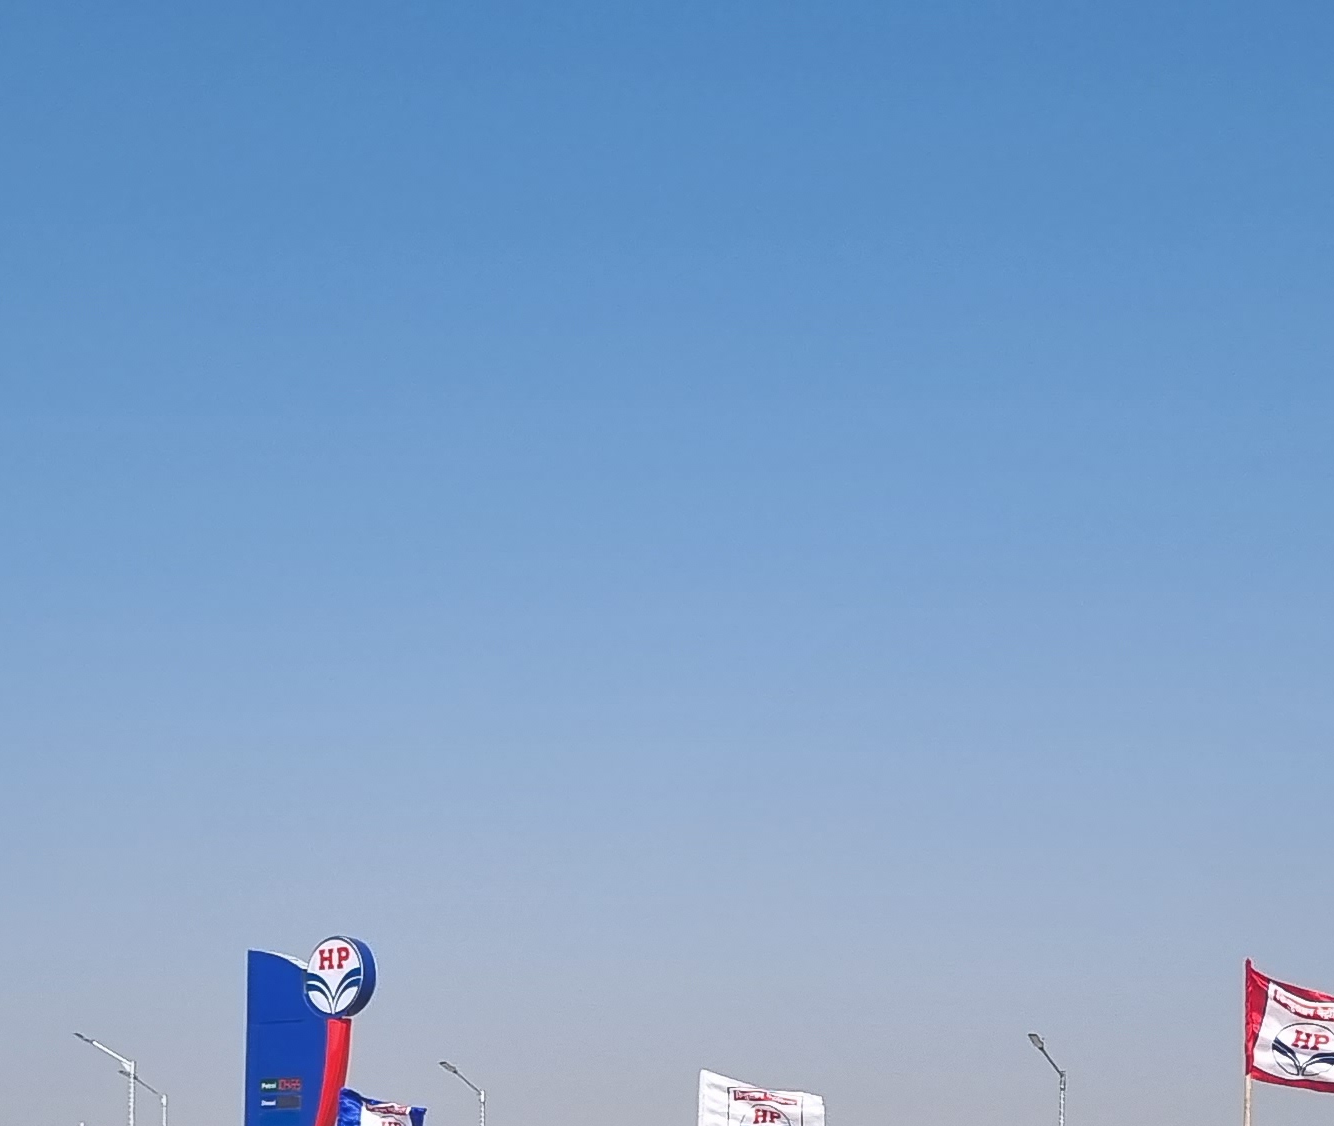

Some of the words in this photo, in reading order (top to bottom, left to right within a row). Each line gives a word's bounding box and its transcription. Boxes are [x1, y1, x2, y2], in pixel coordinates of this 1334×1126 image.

[319, 947, 350, 970] HP
[1291, 1029, 1330, 1050] HP
[753, 1108, 782, 1124] HP
